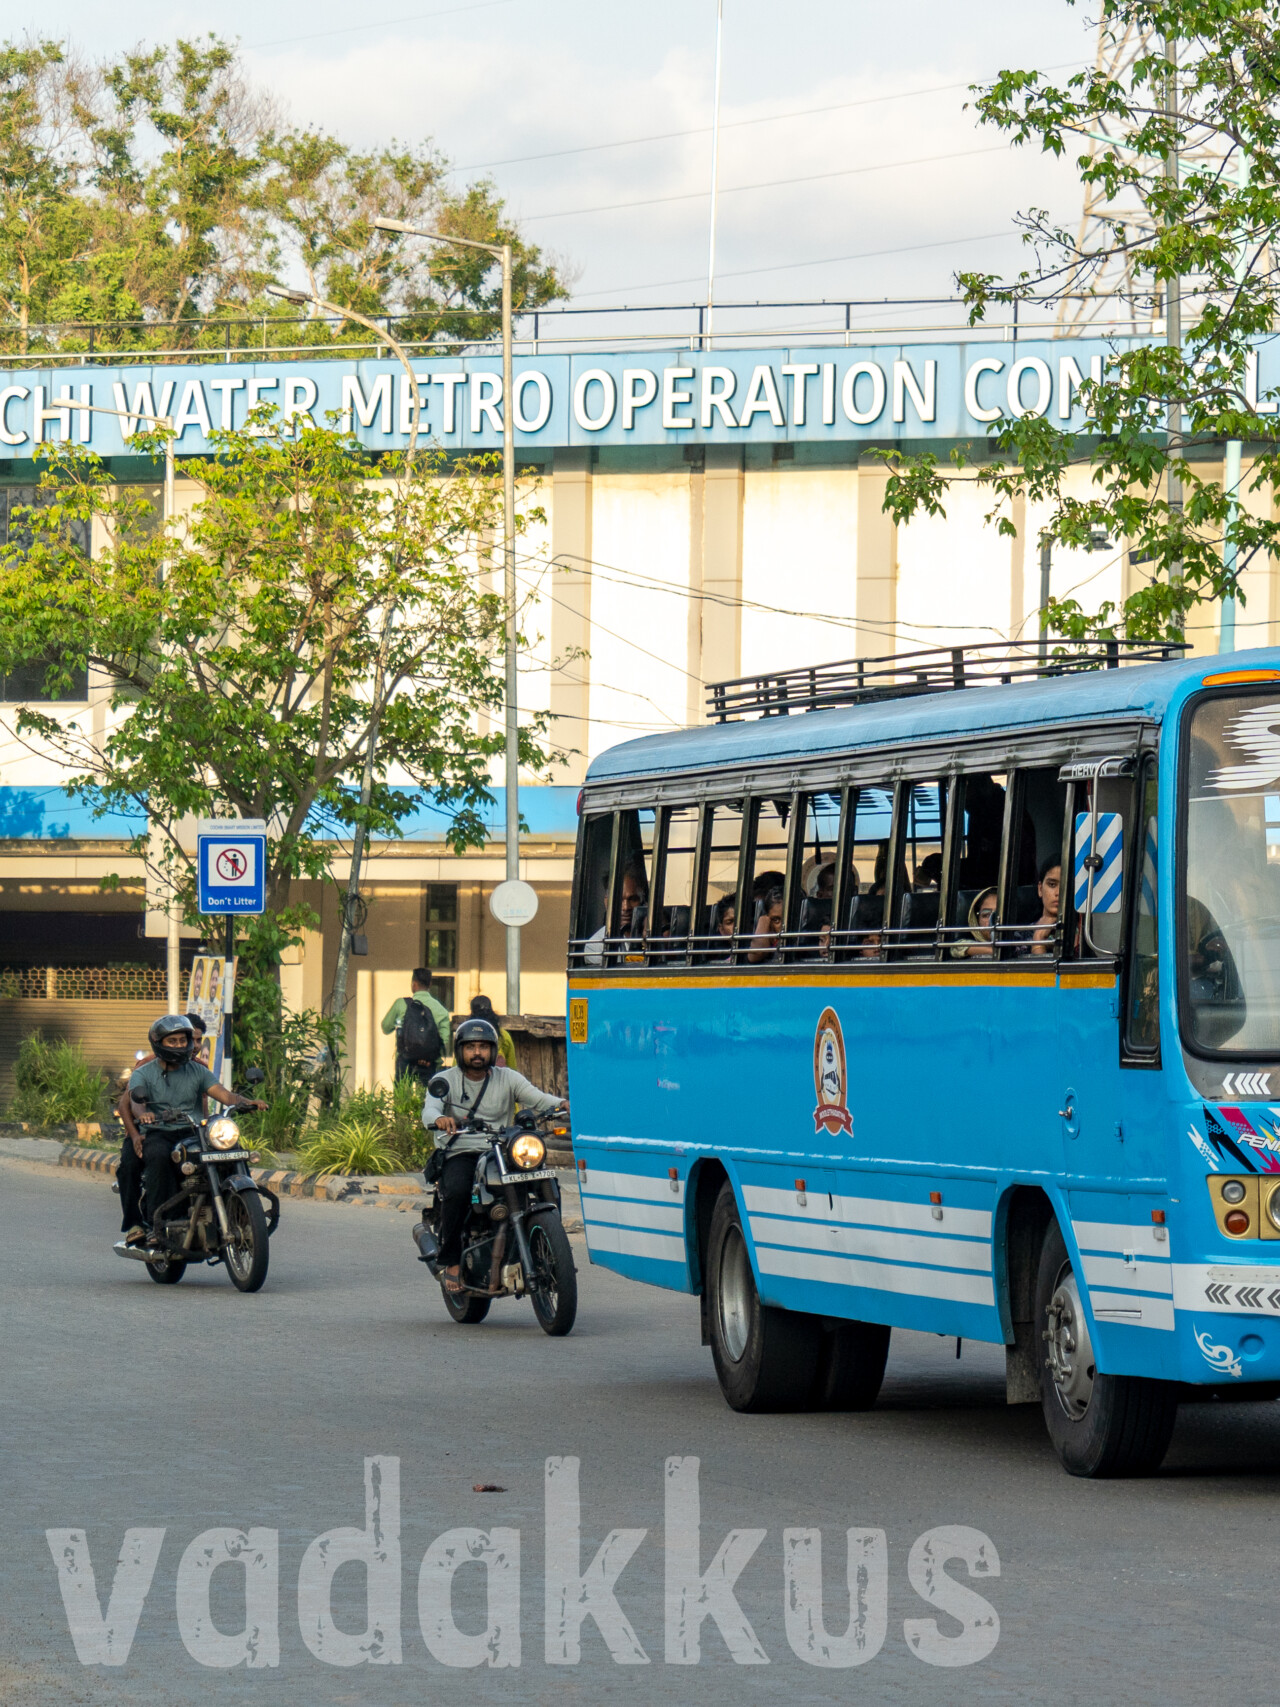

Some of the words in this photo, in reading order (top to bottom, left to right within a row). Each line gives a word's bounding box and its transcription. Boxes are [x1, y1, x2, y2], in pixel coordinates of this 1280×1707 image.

[112, 376, 320, 441] WATER
[342, 370, 553, 435] METRO
[573, 358, 937, 432] OPERATION
[964, 350, 1280, 422] CONOL
[1071, 762, 1109, 778] HEAVN
[208, 896, 232, 906] Don't
[234, 896, 257, 906] Litter
